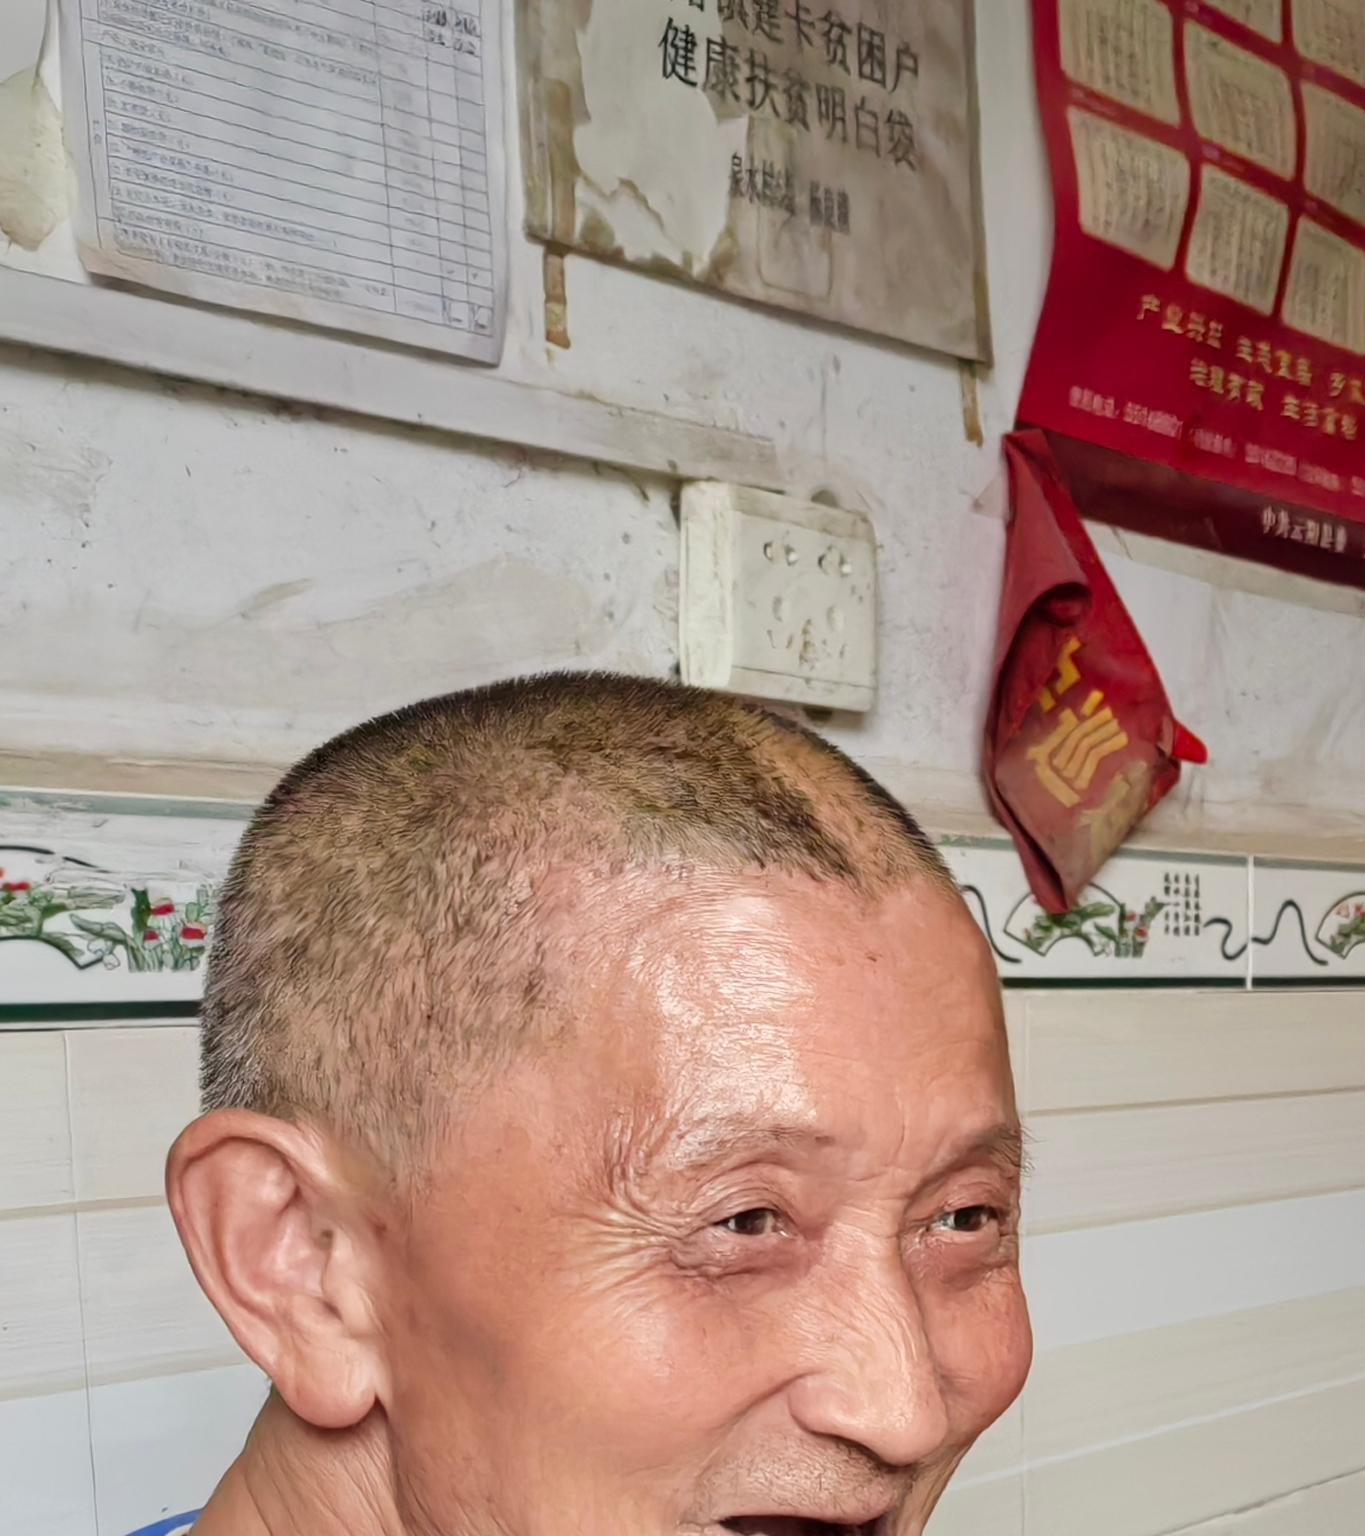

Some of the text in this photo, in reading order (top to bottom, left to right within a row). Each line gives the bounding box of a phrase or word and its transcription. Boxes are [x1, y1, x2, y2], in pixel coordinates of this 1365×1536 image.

[658, 16, 918, 171] 健康扶贫明白袋
